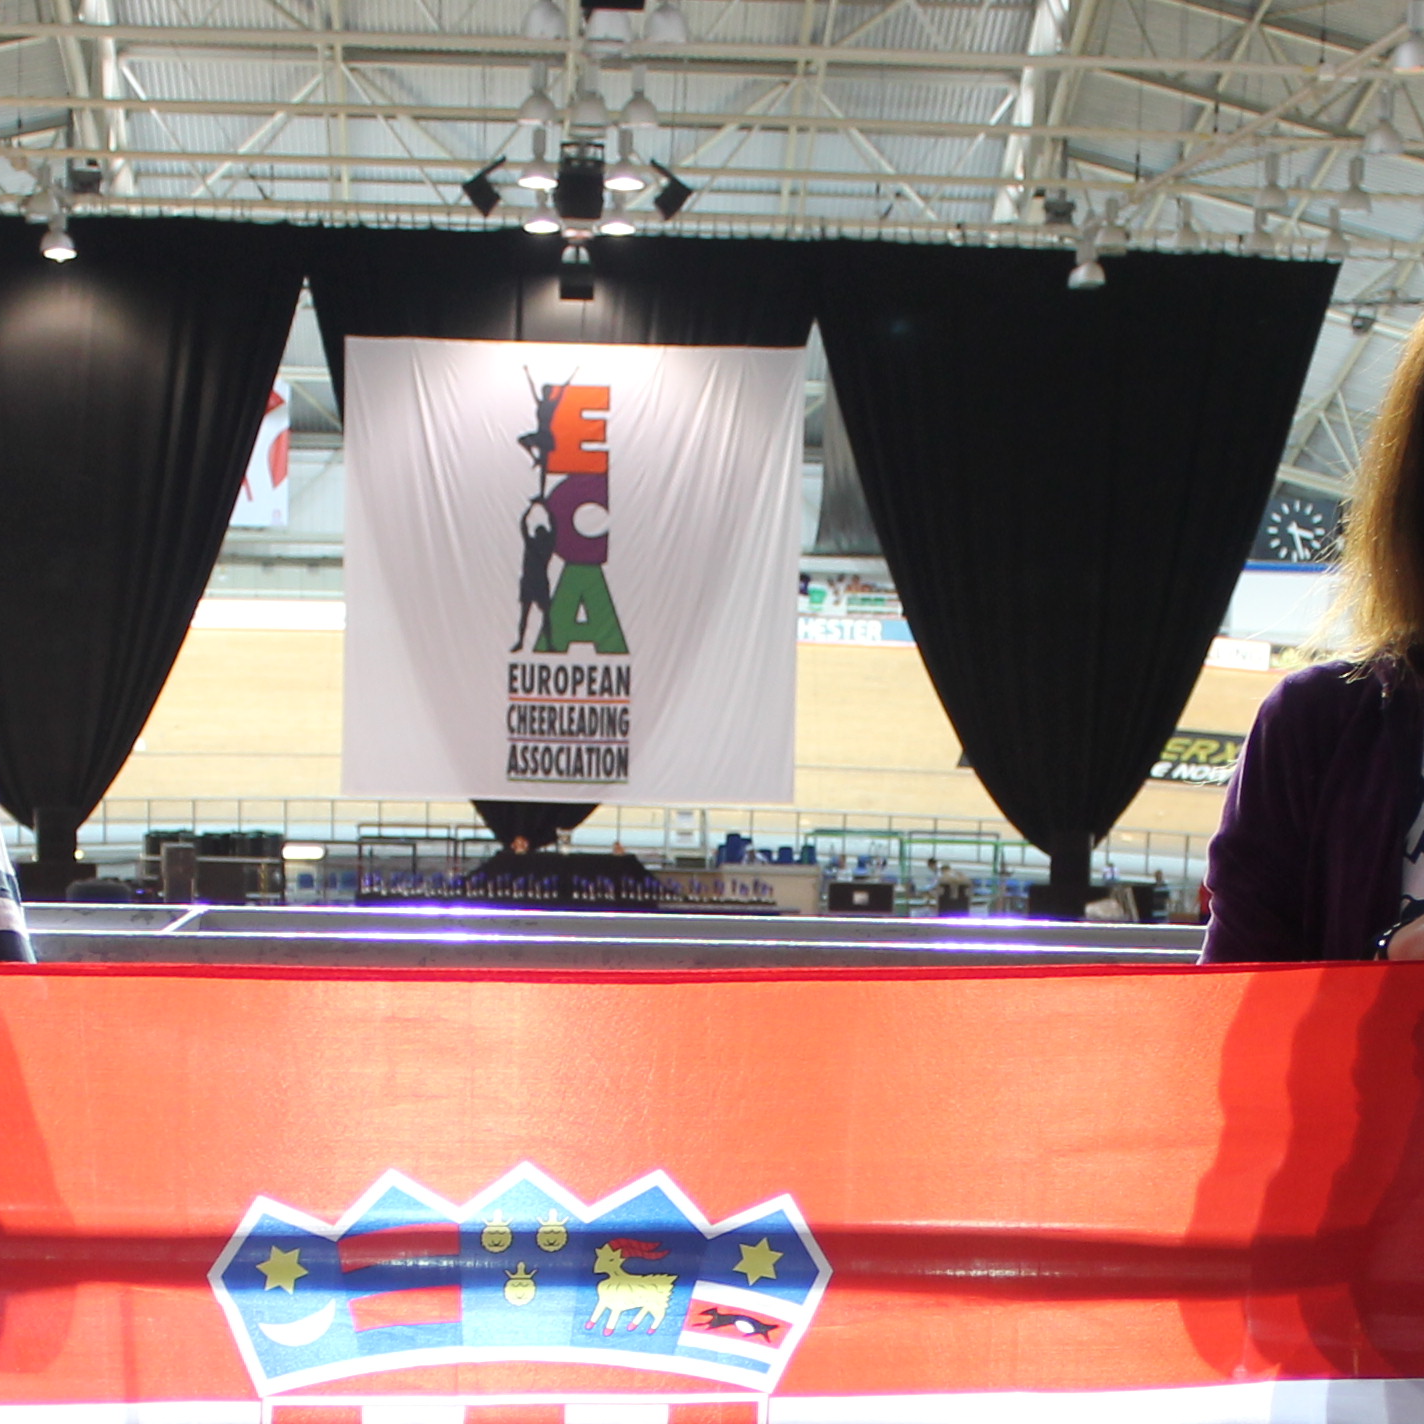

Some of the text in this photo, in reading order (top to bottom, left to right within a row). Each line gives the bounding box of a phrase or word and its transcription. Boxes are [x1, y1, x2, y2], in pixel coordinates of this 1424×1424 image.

[508, 662, 630, 697] EUROPEAN
[507, 703, 629, 737] CHEERLEADING
[507, 744, 629, 778] ASSOCIATION
